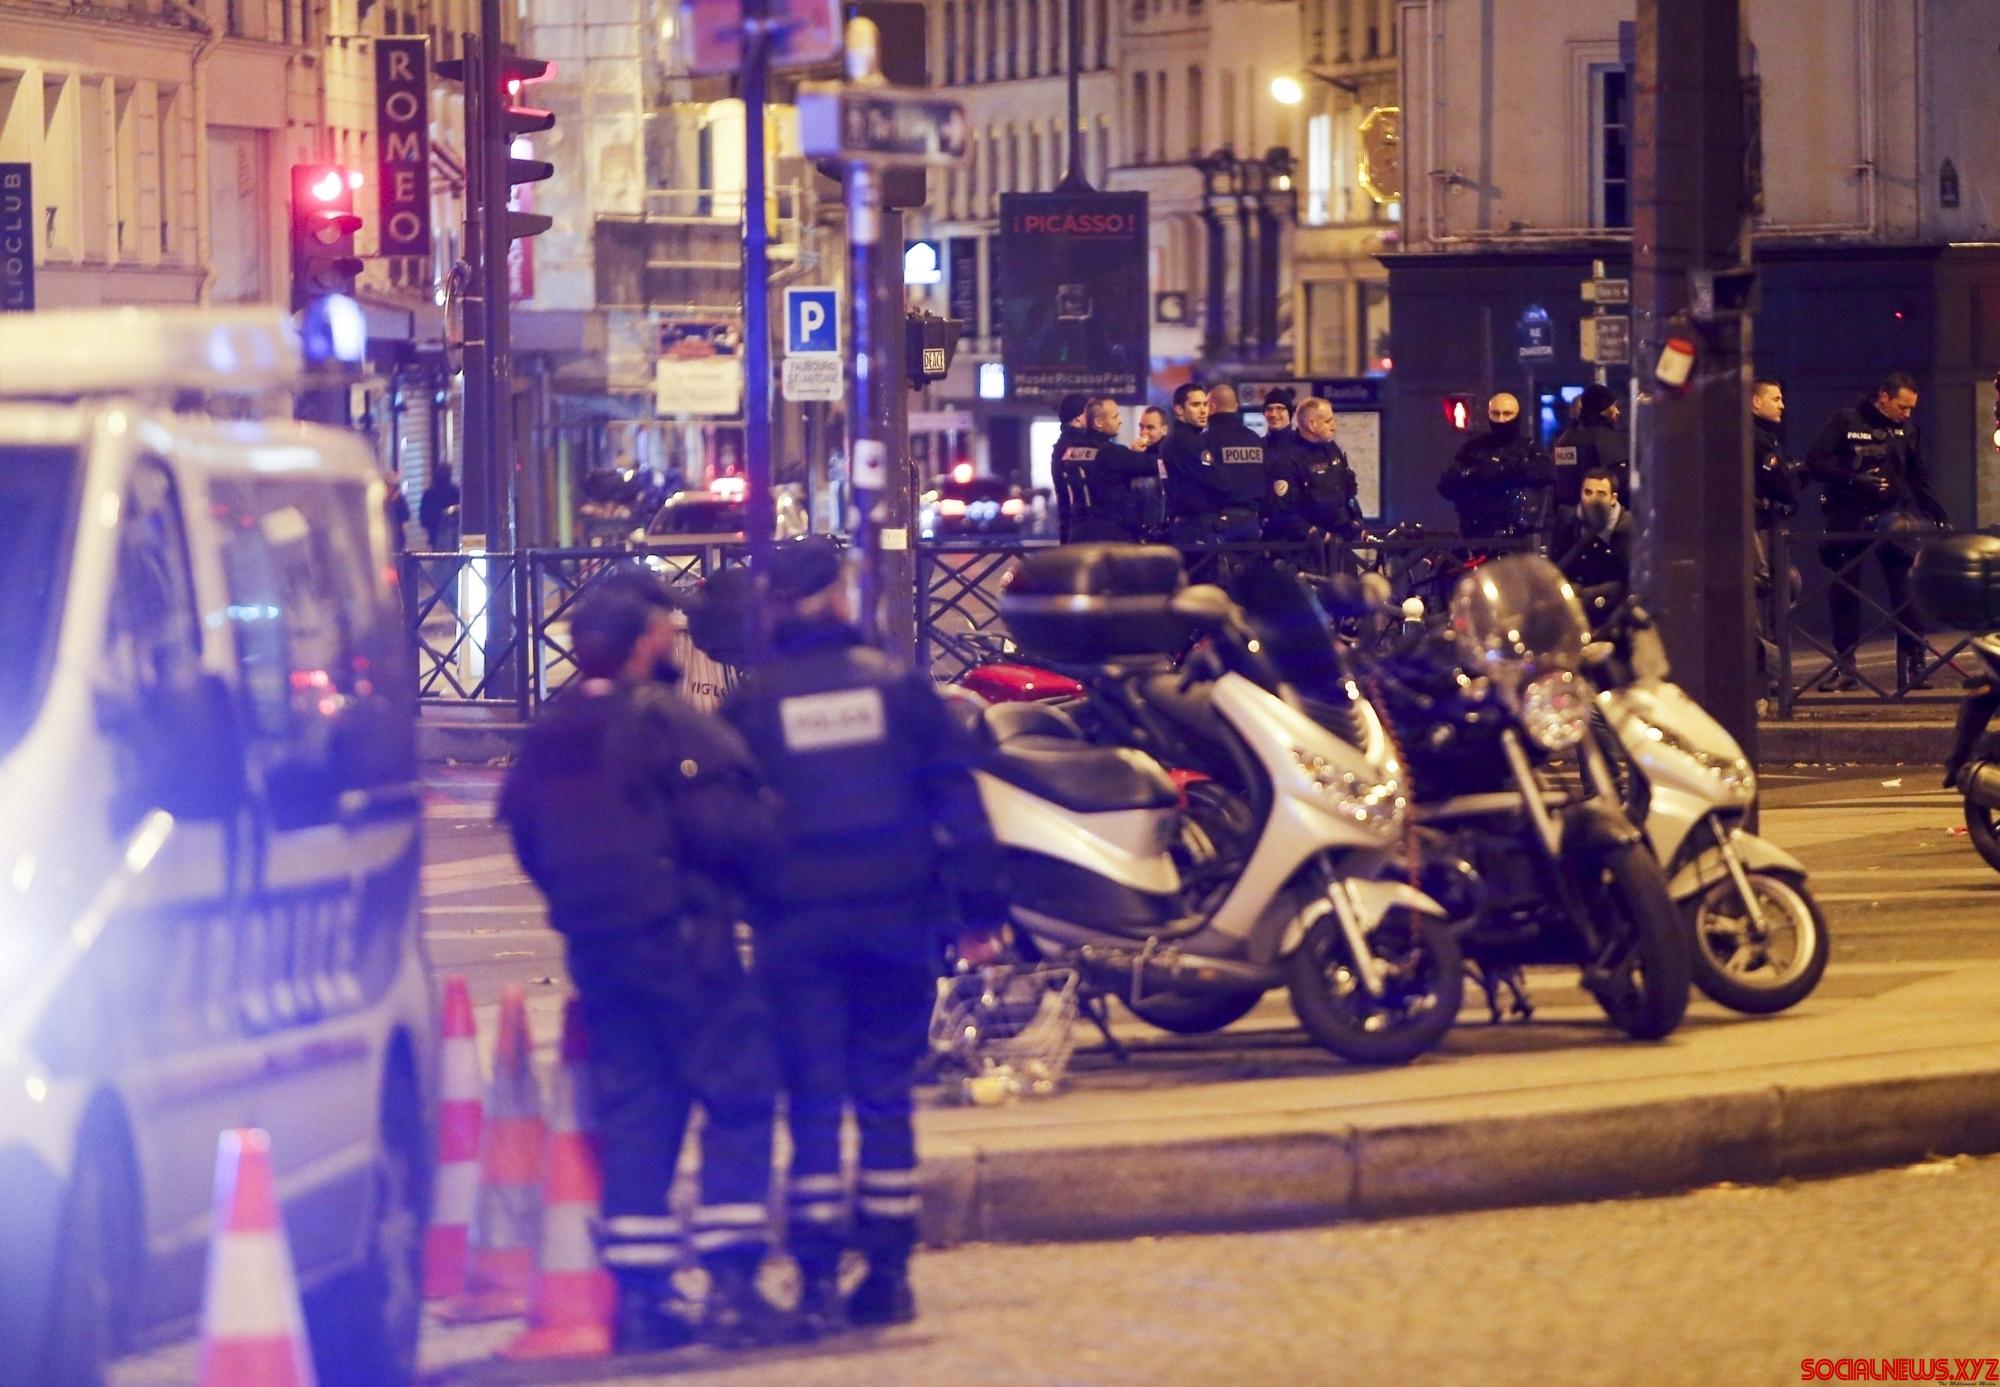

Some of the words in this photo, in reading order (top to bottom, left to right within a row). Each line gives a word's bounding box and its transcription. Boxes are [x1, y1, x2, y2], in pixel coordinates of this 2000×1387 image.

[385, 51, 422, 242] ROMEO
[800, 300, 825, 343] P
[1846, 431, 1872, 440] POLICE
[1225, 449, 1261, 461] POLICE
